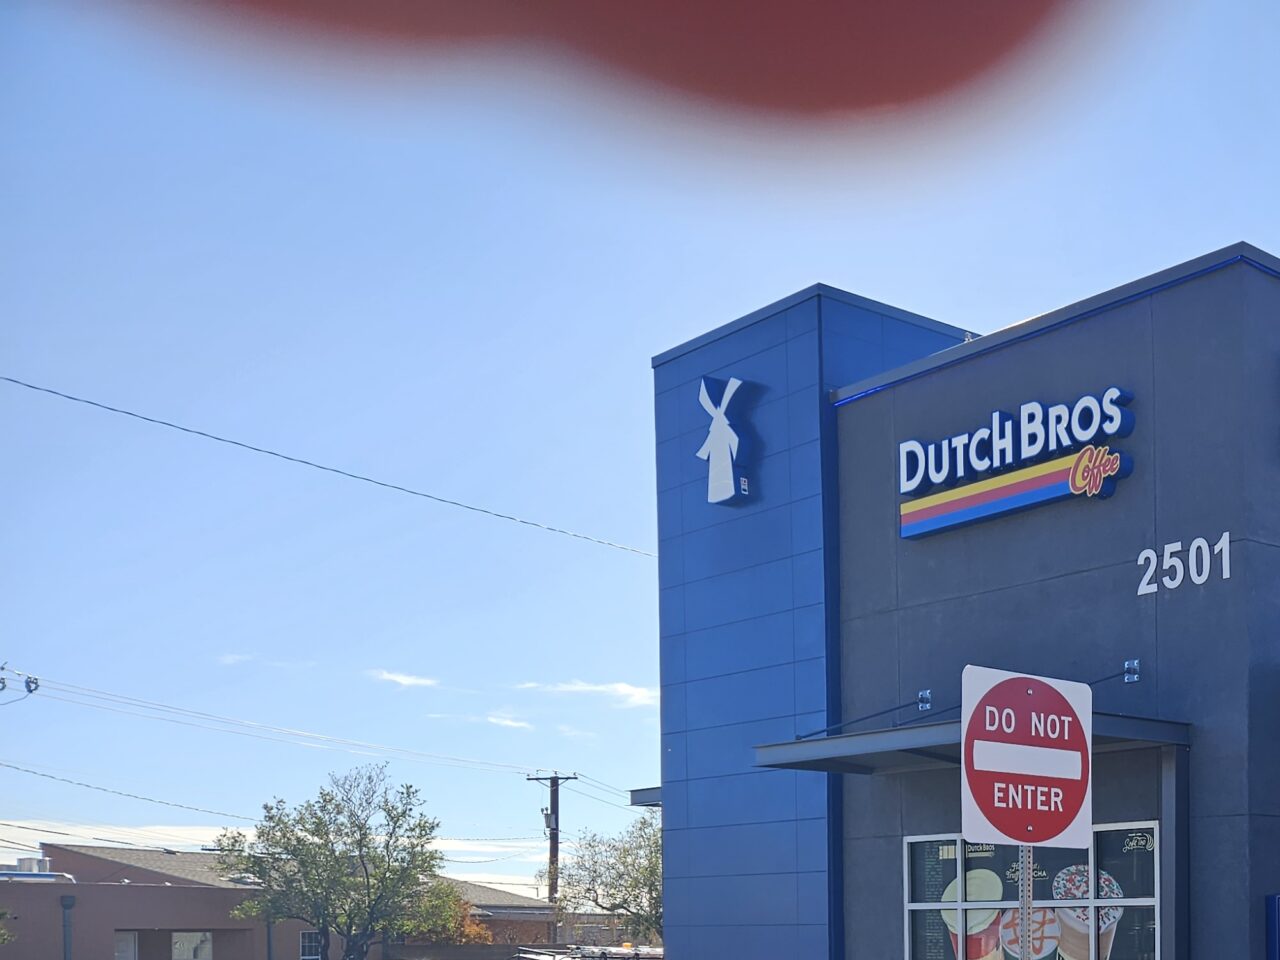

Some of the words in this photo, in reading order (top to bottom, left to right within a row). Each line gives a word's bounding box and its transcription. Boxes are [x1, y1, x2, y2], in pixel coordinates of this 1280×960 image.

[900, 410, 1013, 493] DUTCH
[1020, 387, 1122, 459] BROS
[1069, 445, 1120, 497] Coffee
[1137, 531, 1231, 596] 2501
[985, 705, 1016, 733] DO
[1031, 711, 1073, 740] NOT
[994, 782, 1063, 812] ENTER
